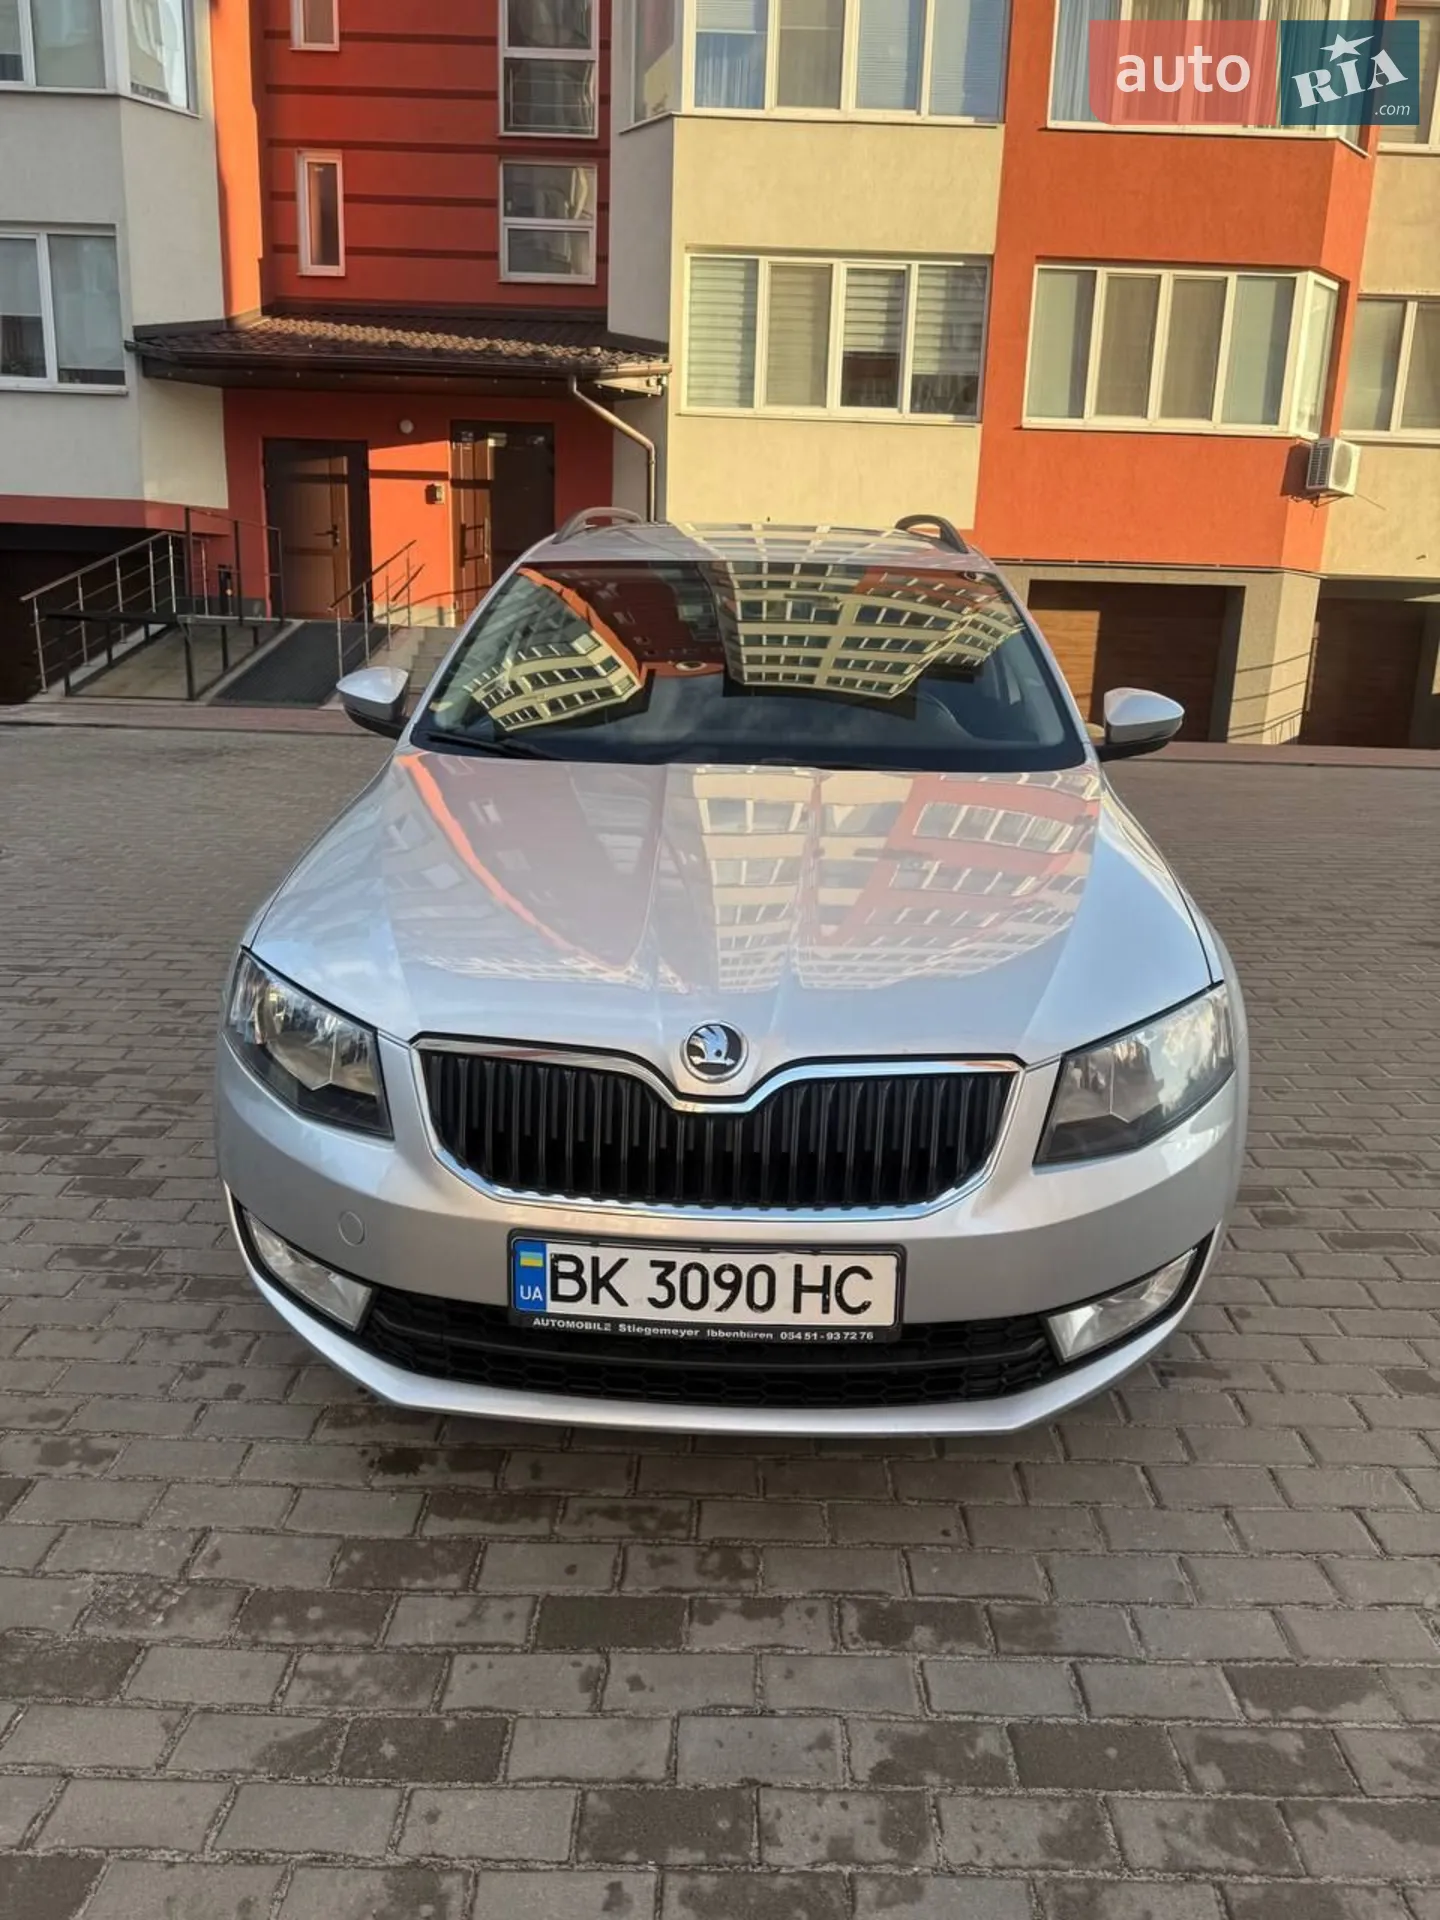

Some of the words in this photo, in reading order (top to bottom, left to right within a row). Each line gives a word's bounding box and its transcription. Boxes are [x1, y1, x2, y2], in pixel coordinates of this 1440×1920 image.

[520, 1285, 543, 1302] UA
[549, 1253, 628, 1307] BK
[647, 1259, 776, 1314] 3090
[792, 1264, 873, 1315] HC
